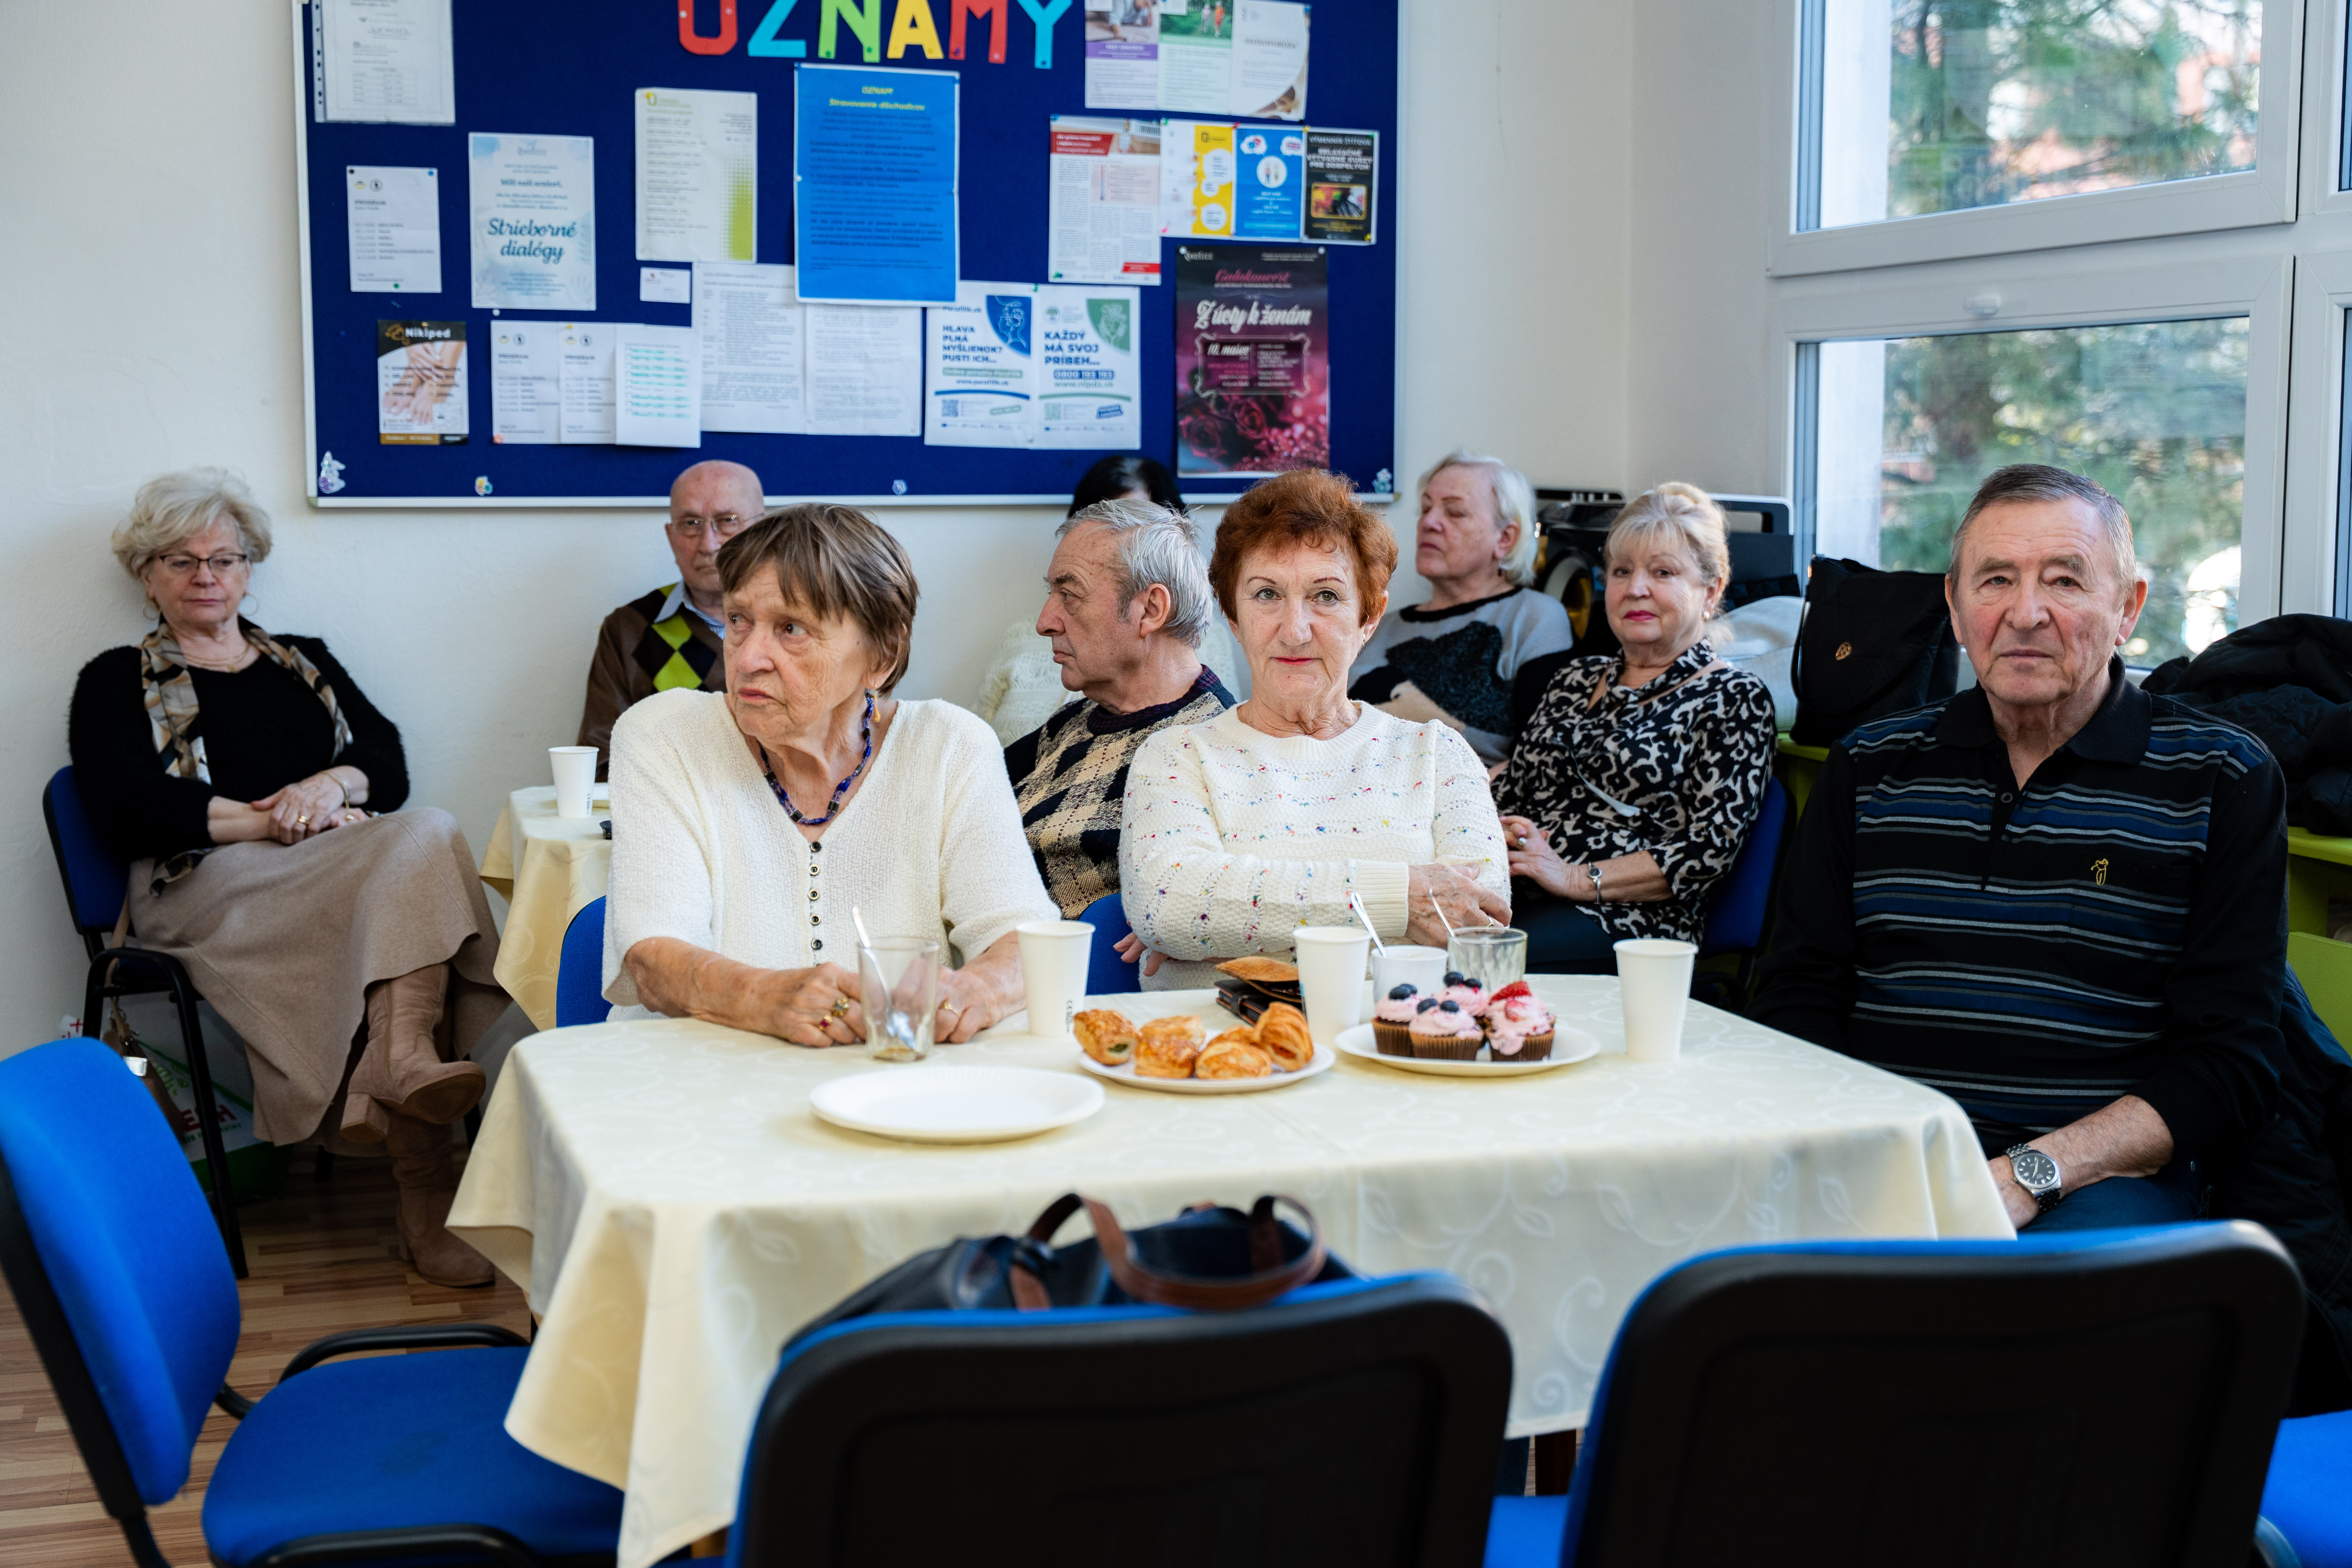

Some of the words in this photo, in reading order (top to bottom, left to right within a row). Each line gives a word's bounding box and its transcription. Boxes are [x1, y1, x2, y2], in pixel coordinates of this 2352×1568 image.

[678, 0, 1073, 69] OZNAMY
[487, 217, 578, 238] Strieborné
[500, 240, 565, 265] dialógy
[1247, 300, 1260, 325] k
[1259, 303, 1312, 326] ženám
[405, 327, 451, 340] Nikiped
[1044, 328, 1085, 340] KAŽDÝ
[942, 344, 1002, 353] MYŠLIENOK?
[1044, 343, 1063, 352] MÁ
[1068, 344, 1099, 353] SVOJ
[1044, 354, 1100, 365] PRÍBEH...
